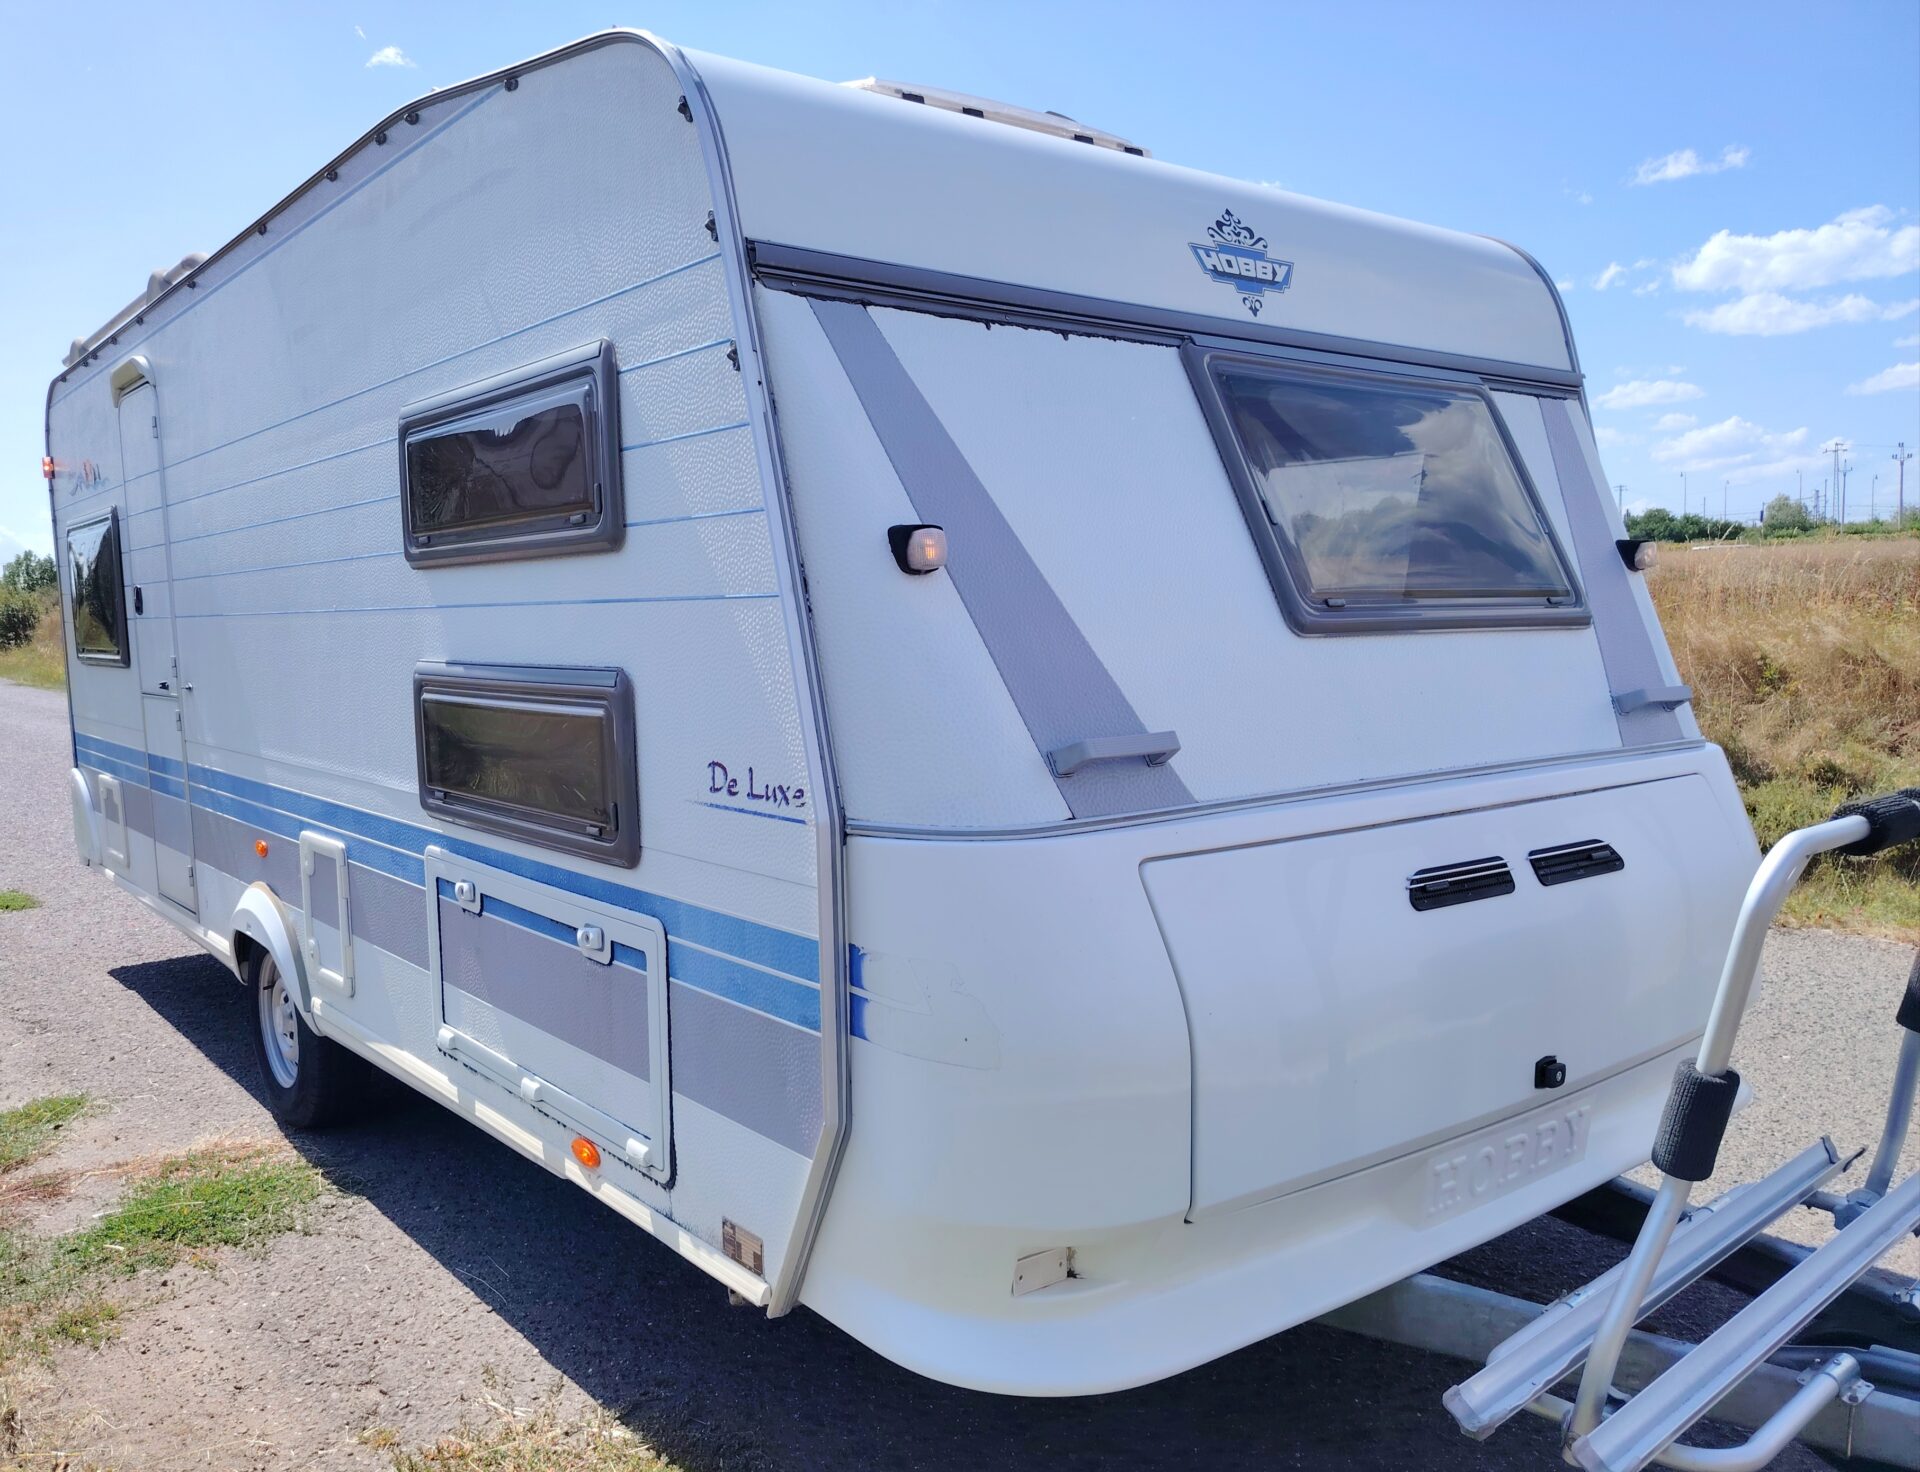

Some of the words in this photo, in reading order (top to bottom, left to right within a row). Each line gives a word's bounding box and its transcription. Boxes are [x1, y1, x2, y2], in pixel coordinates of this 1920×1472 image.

[1196, 248, 1290, 283] HOBBY
[707, 760, 739, 796] De
[746, 766, 806, 808] Luxe
[1427, 1105, 1591, 1216] HOBBY
